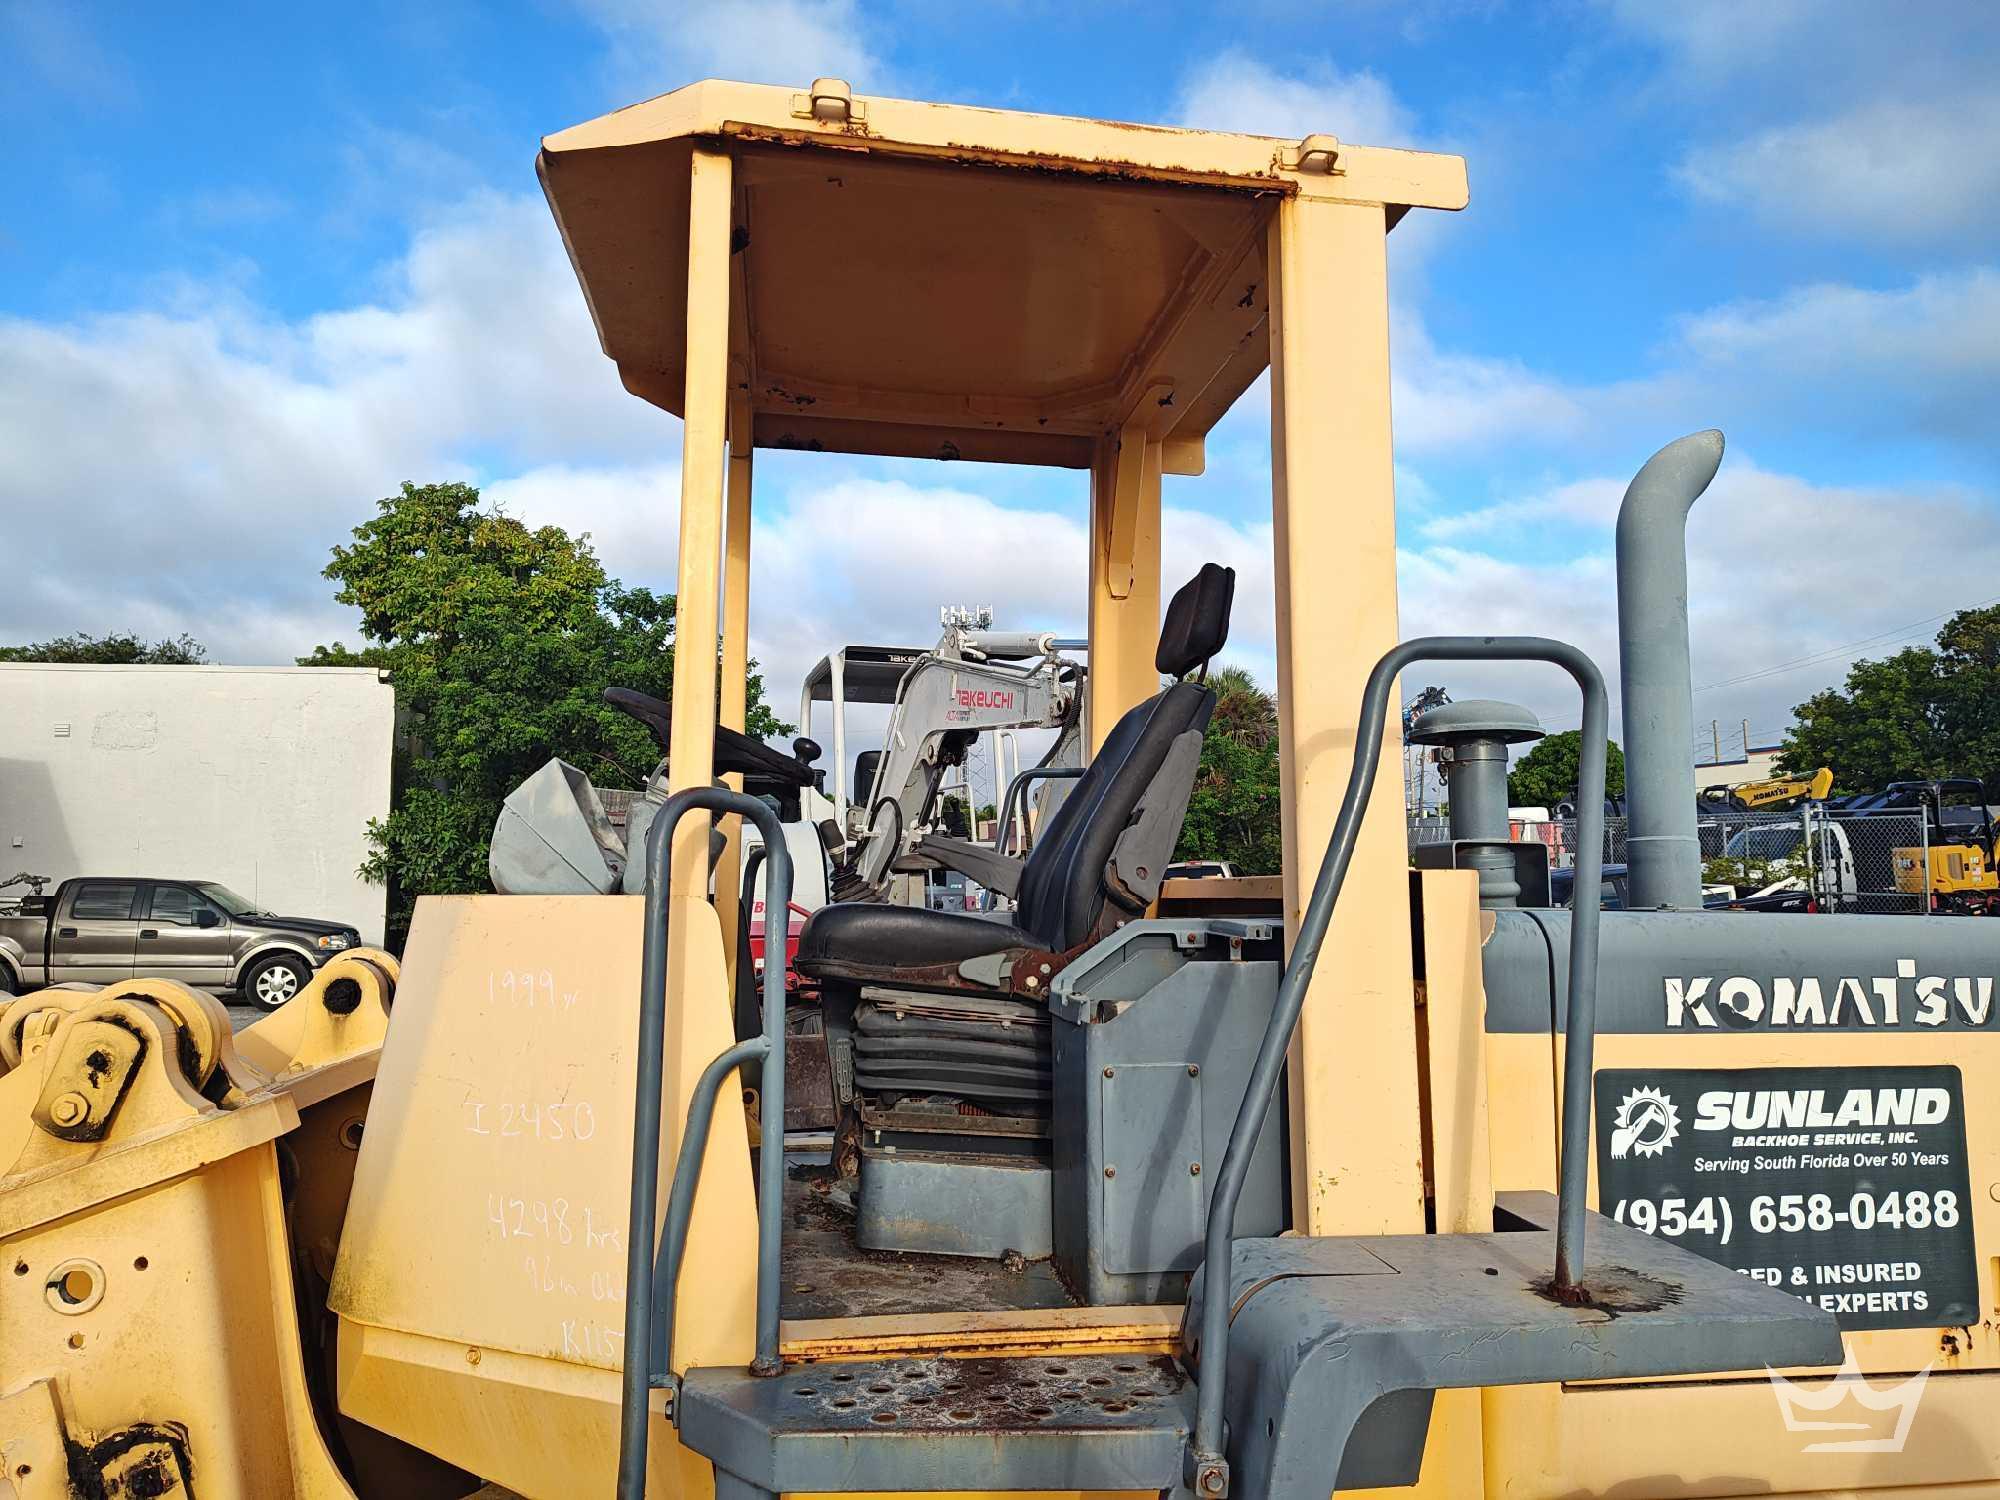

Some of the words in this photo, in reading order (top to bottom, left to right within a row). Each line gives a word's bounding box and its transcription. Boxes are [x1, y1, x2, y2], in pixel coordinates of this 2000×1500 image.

[1753, 787, 1789, 800] KOMATSU
[488, 969, 556, 1008] 1999
[1664, 959, 1993, 1028] KOMATSU
[1693, 1088, 1950, 1131] SUNLAND
[1731, 1134, 1810, 1148] BACKHOE
[1813, 1132, 1885, 1146] SERVICE,
[1888, 1131, 1919, 1144] INC.
[1694, 1157, 1750, 1174] Serving
[1753, 1154, 1796, 1170] South
[1800, 1153, 1850, 1169] Florida
[1853, 1153, 1888, 1167] Over
[1891, 1152, 1907, 1166] 50
[1911, 1151, 1949, 1166] Years
[1749, 1190, 1960, 1234] 658-0488
[1790, 1266, 1808, 1286] &
[1815, 1262, 1922, 1285] INSURED
[1820, 1290, 1929, 1313] EXPERTS
